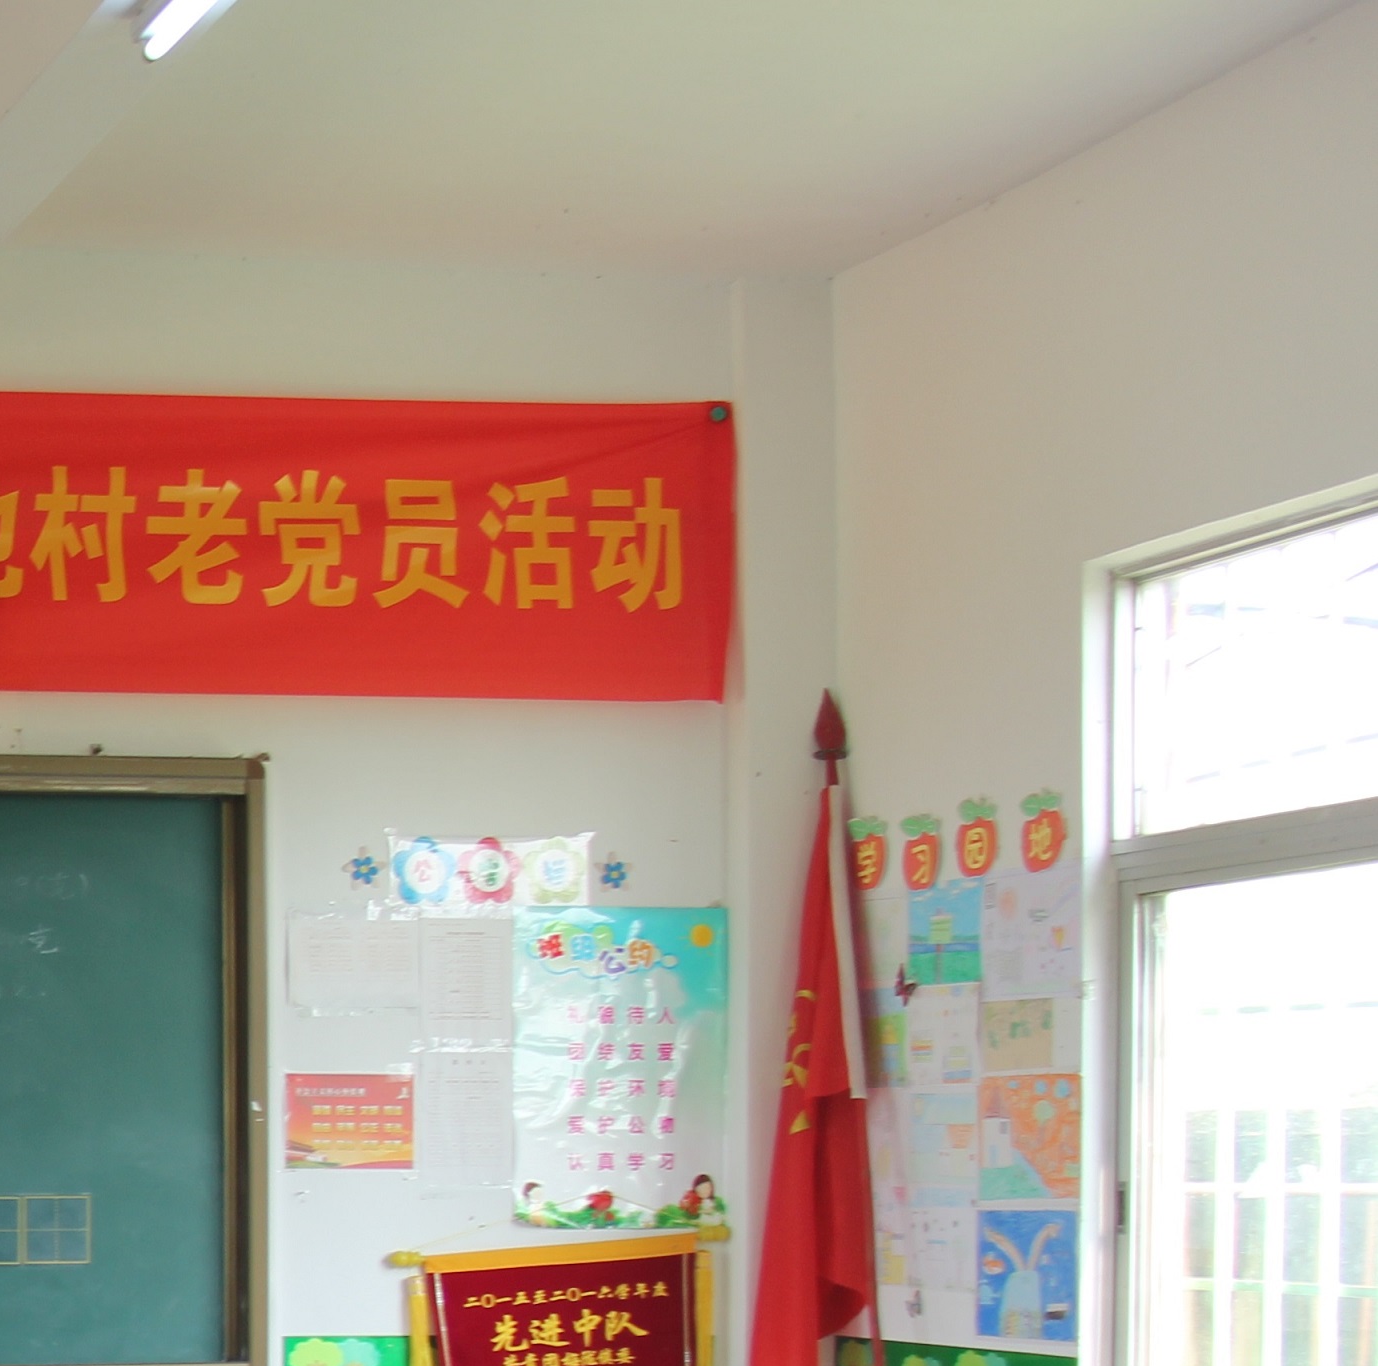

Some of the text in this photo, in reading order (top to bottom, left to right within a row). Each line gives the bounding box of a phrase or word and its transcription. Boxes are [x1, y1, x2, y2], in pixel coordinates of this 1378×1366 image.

[857, 818, 1053, 884] 学习园地
[568, 1043, 675, 1061] 团结友爱
[569, 1079, 676, 1098] 保护环境
[567, 1115, 675, 1134] 爱护公物
[568, 1153, 675, 1170] 认真学习
[490, 1308, 650, 1351] 先进中队
